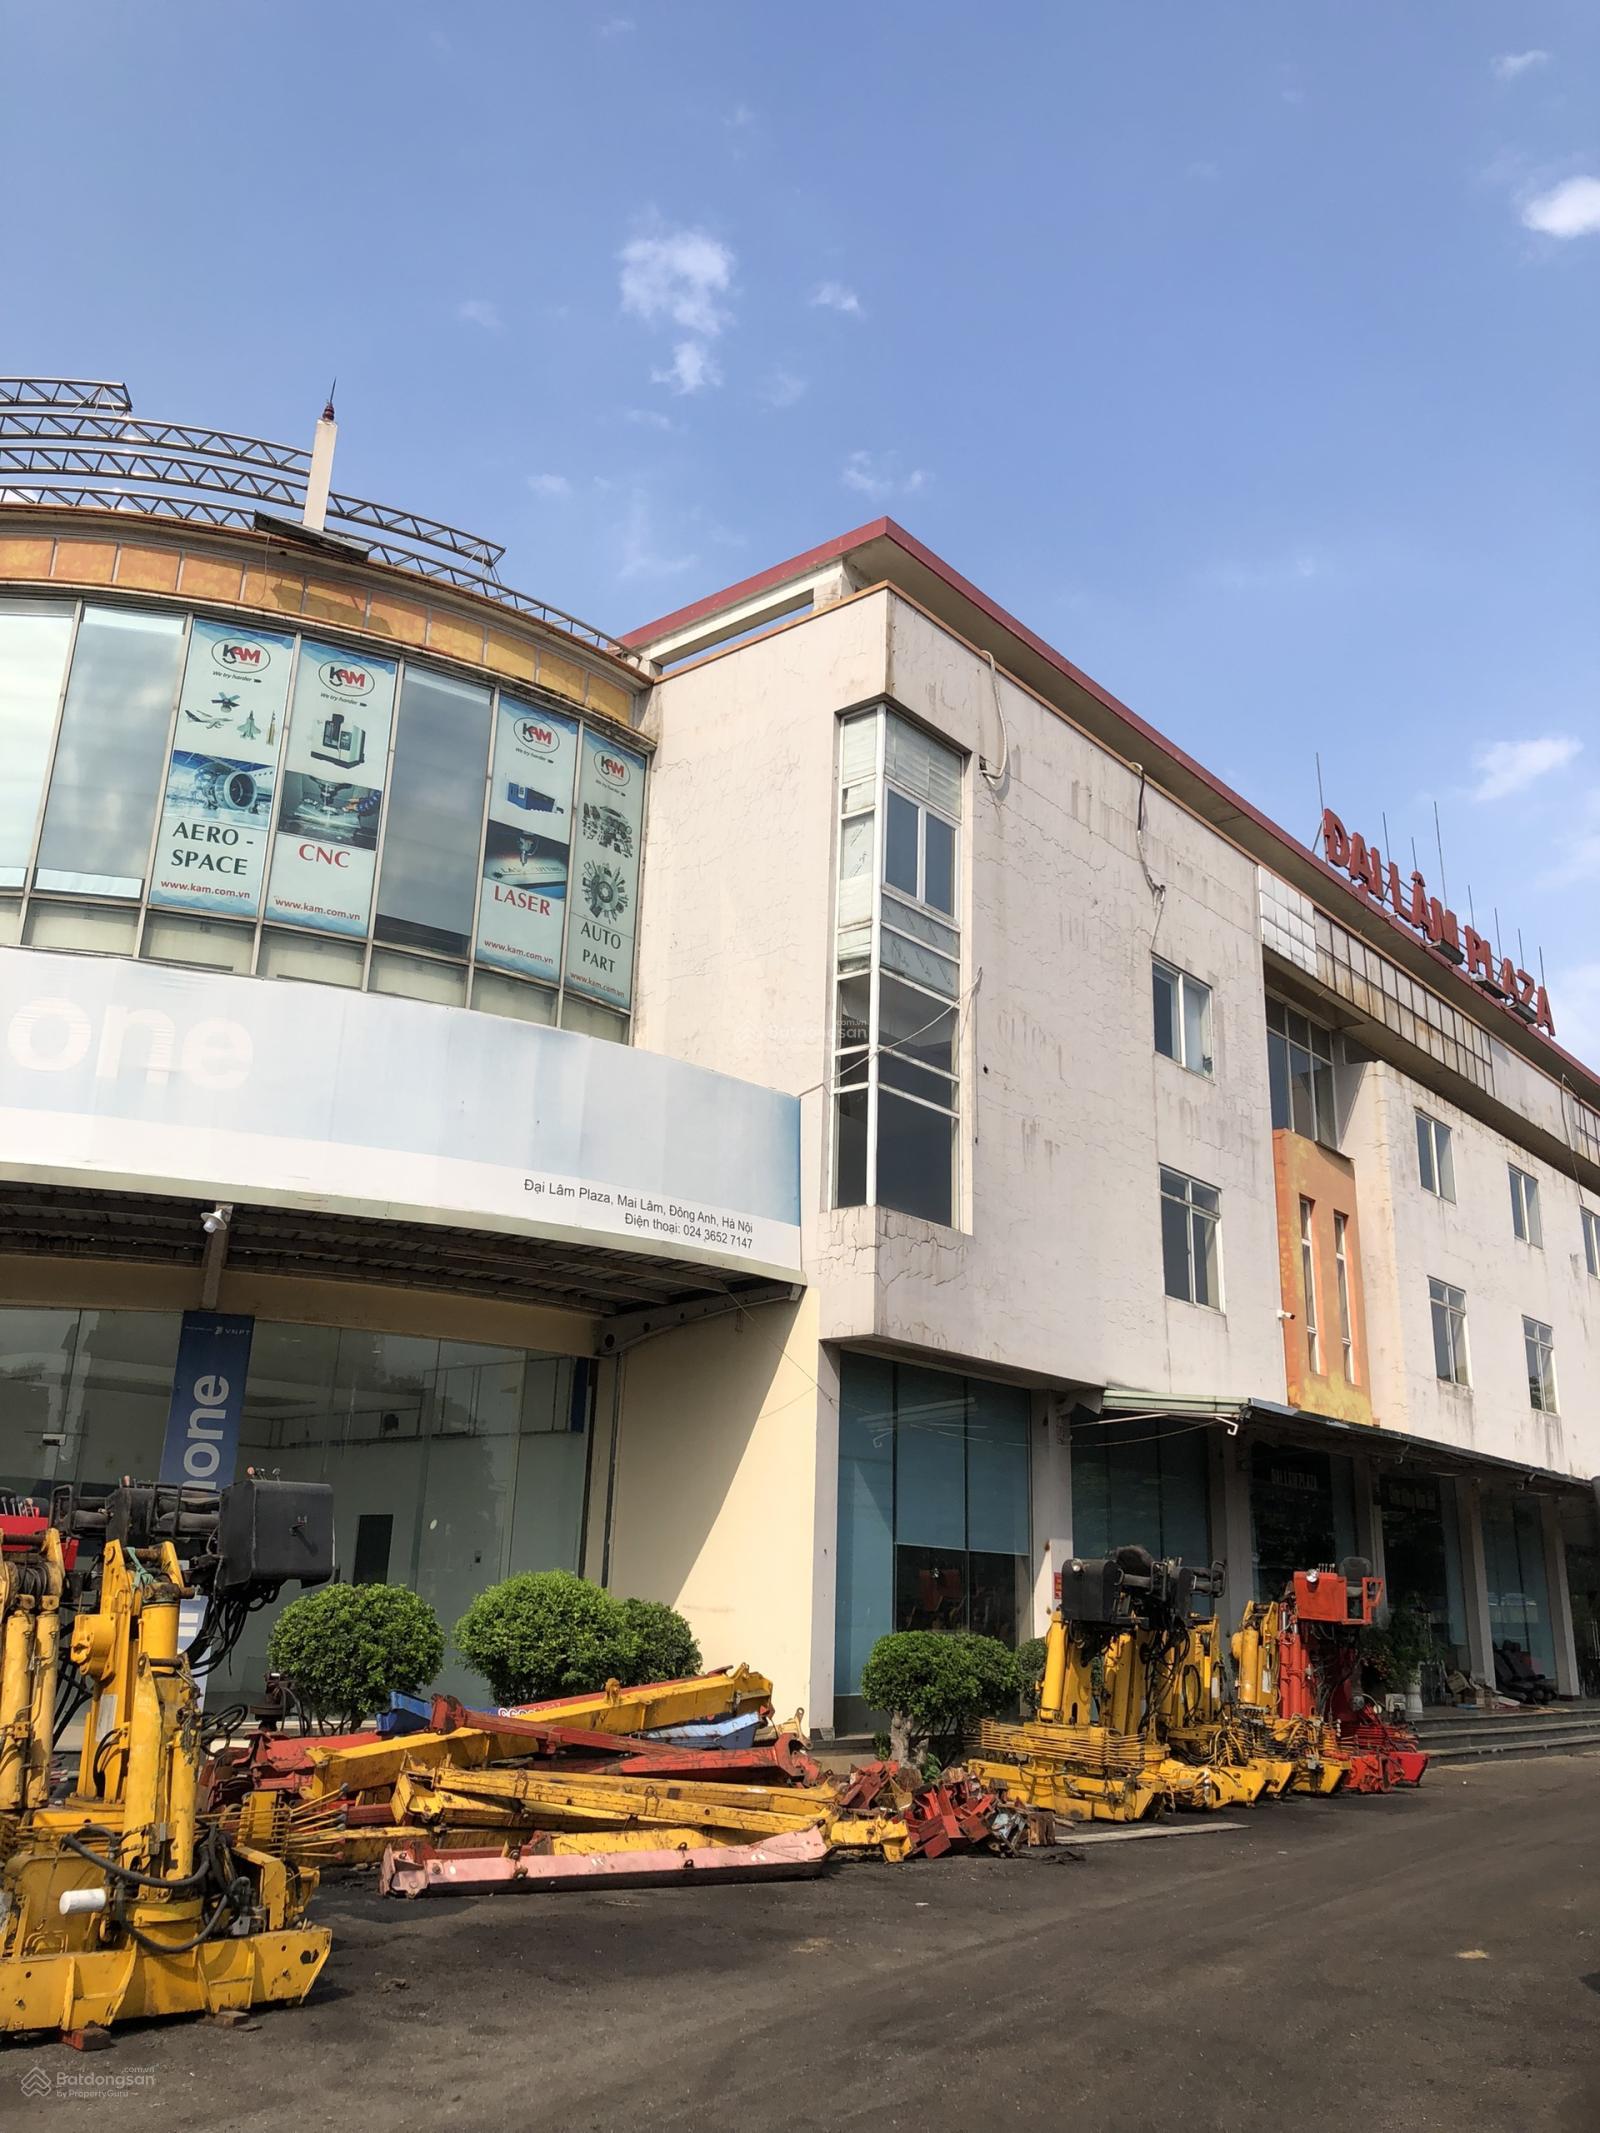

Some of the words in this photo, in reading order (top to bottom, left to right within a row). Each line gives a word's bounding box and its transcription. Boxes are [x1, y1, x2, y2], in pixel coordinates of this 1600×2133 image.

[222, 644, 261, 664] KAM
[232, 674, 252, 682] harder
[329, 665, 366, 687] KAM
[522, 722, 552, 745] KAM
[600, 755, 624, 778] KAM
[172, 821, 239, 846] AERO
[171, 849, 248, 876] SPACE
[299, 844, 351, 868] CNC
[160, 879, 251, 900] www.kam.com.vn
[494, 885, 551, 917] LASER
[275, 897, 361, 921] www.kam.com.vn
[580, 921, 622, 950] AUTO
[484, 939, 554, 965] www.kam.com.vn
[582, 949, 616, 973] PART
[570, 972, 625, 998] www.kam.com.vn
[524, 1178, 545, 1195] Đại
[549, 1182, 575, 1197] Lâm
[579, 1187, 613, 1205] Plaza,
[617, 1194, 637, 1208] Mai
[640, 1198, 666, 1215] Lâm,
[669, 1204, 695, 1224] Đông
[698, 1211, 718, 1227] Anh,
[738, 1219, 753, 1234] Nội
[625, 1212, 649, 1229] Điện
[653, 1218, 680, 1235] thoại:
[683, 1224, 701, 1238] 024
[704, 1229, 728, 1244] 3652
[730, 1234, 753, 1249] 7147
[224, 1328, 251, 1336] VNPT
